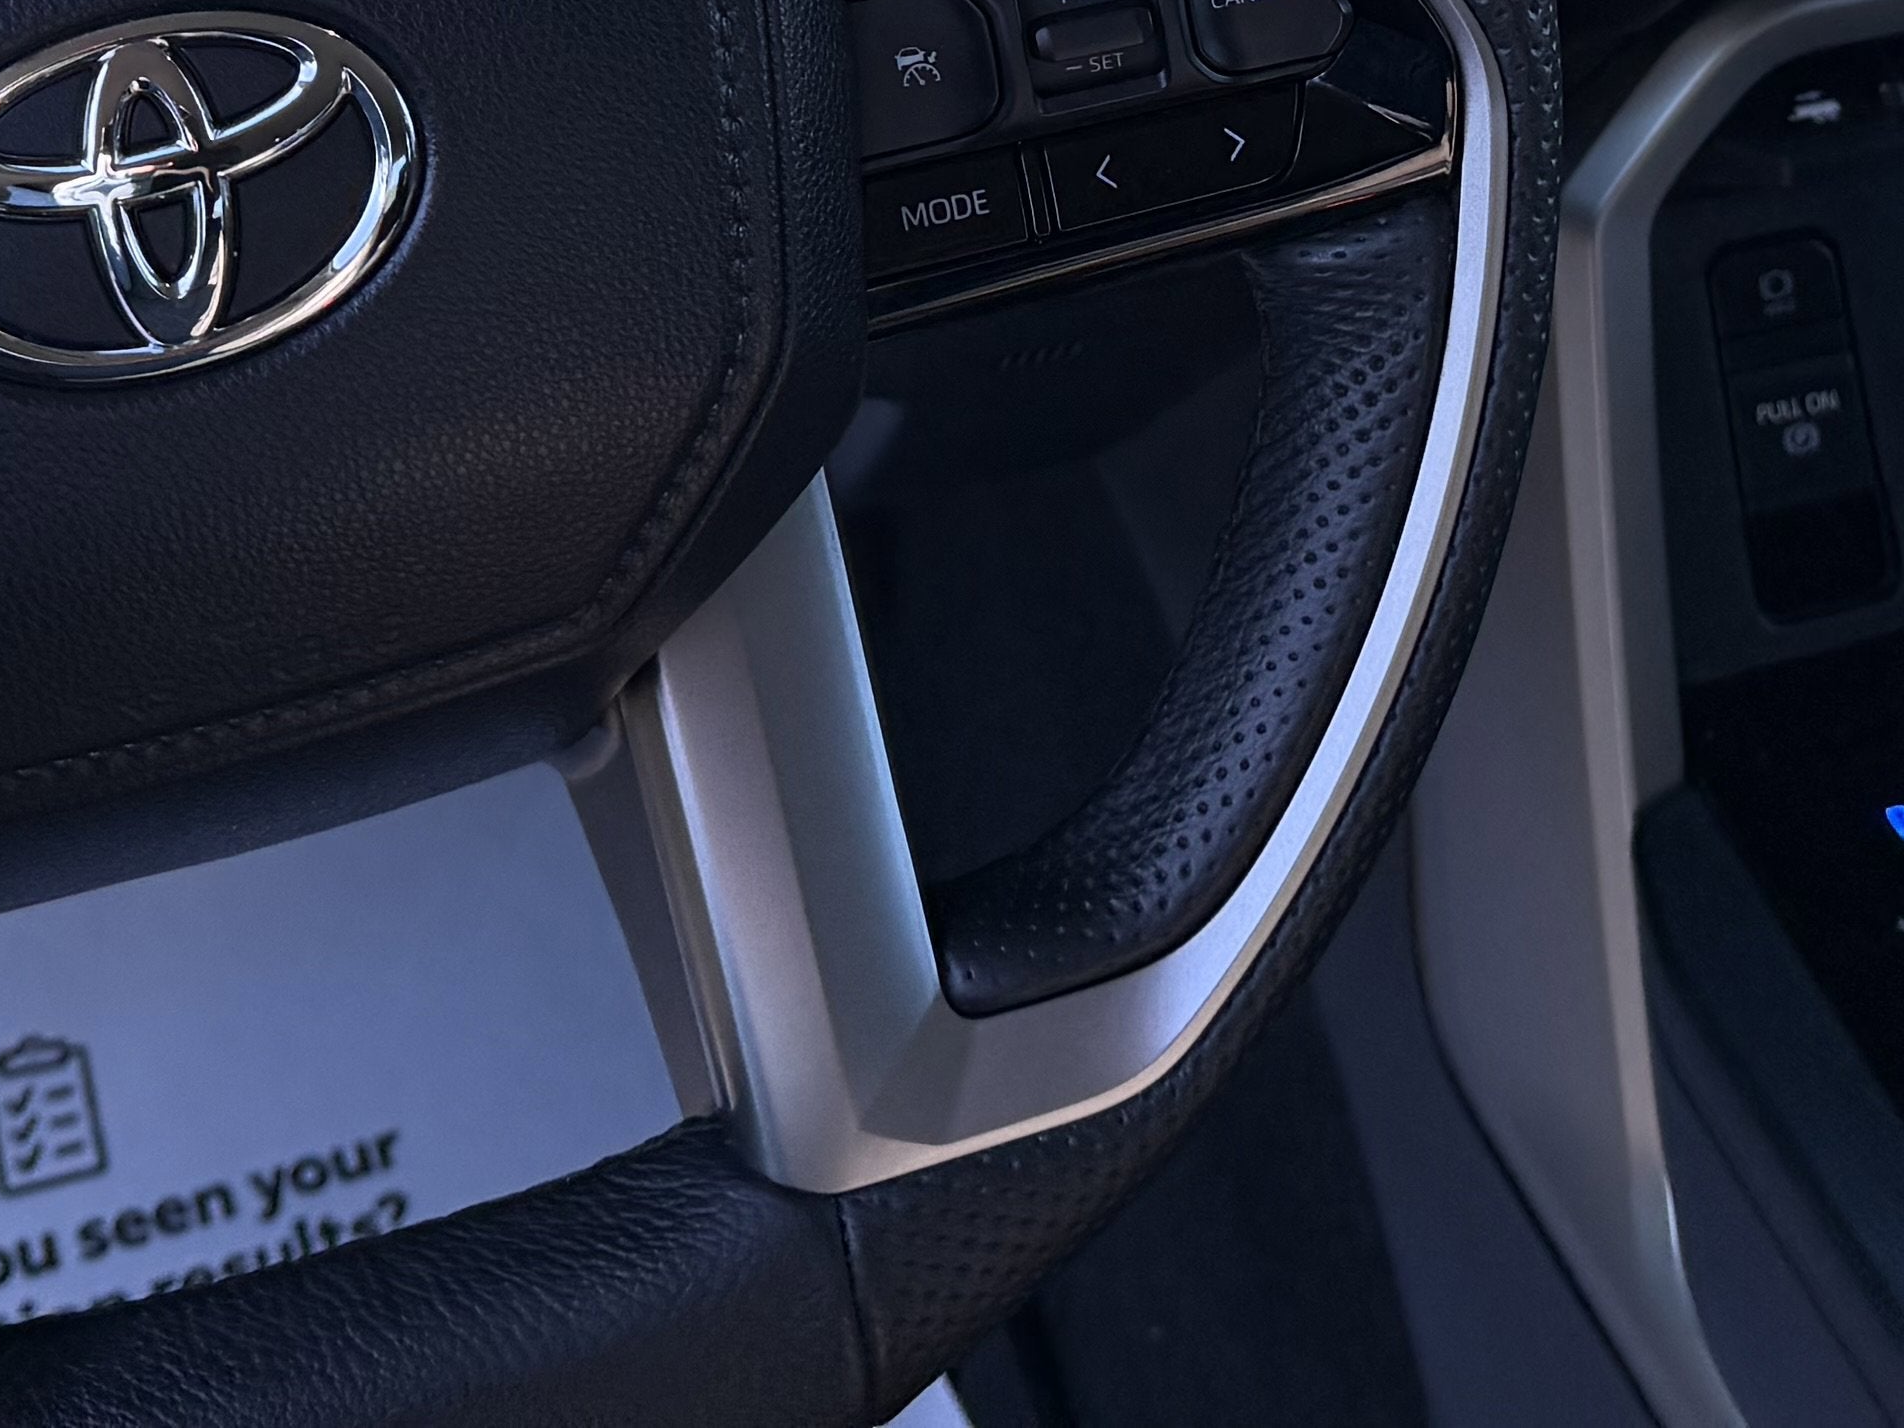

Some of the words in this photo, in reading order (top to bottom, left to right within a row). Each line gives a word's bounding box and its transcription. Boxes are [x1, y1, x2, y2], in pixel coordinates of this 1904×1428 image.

[900, 188, 991, 232] MODE
[1754, 396, 1804, 426] PULL
[1804, 388, 1842, 416] ON
[79, 1181, 236, 1261] seen
[251, 1128, 404, 1218] your
